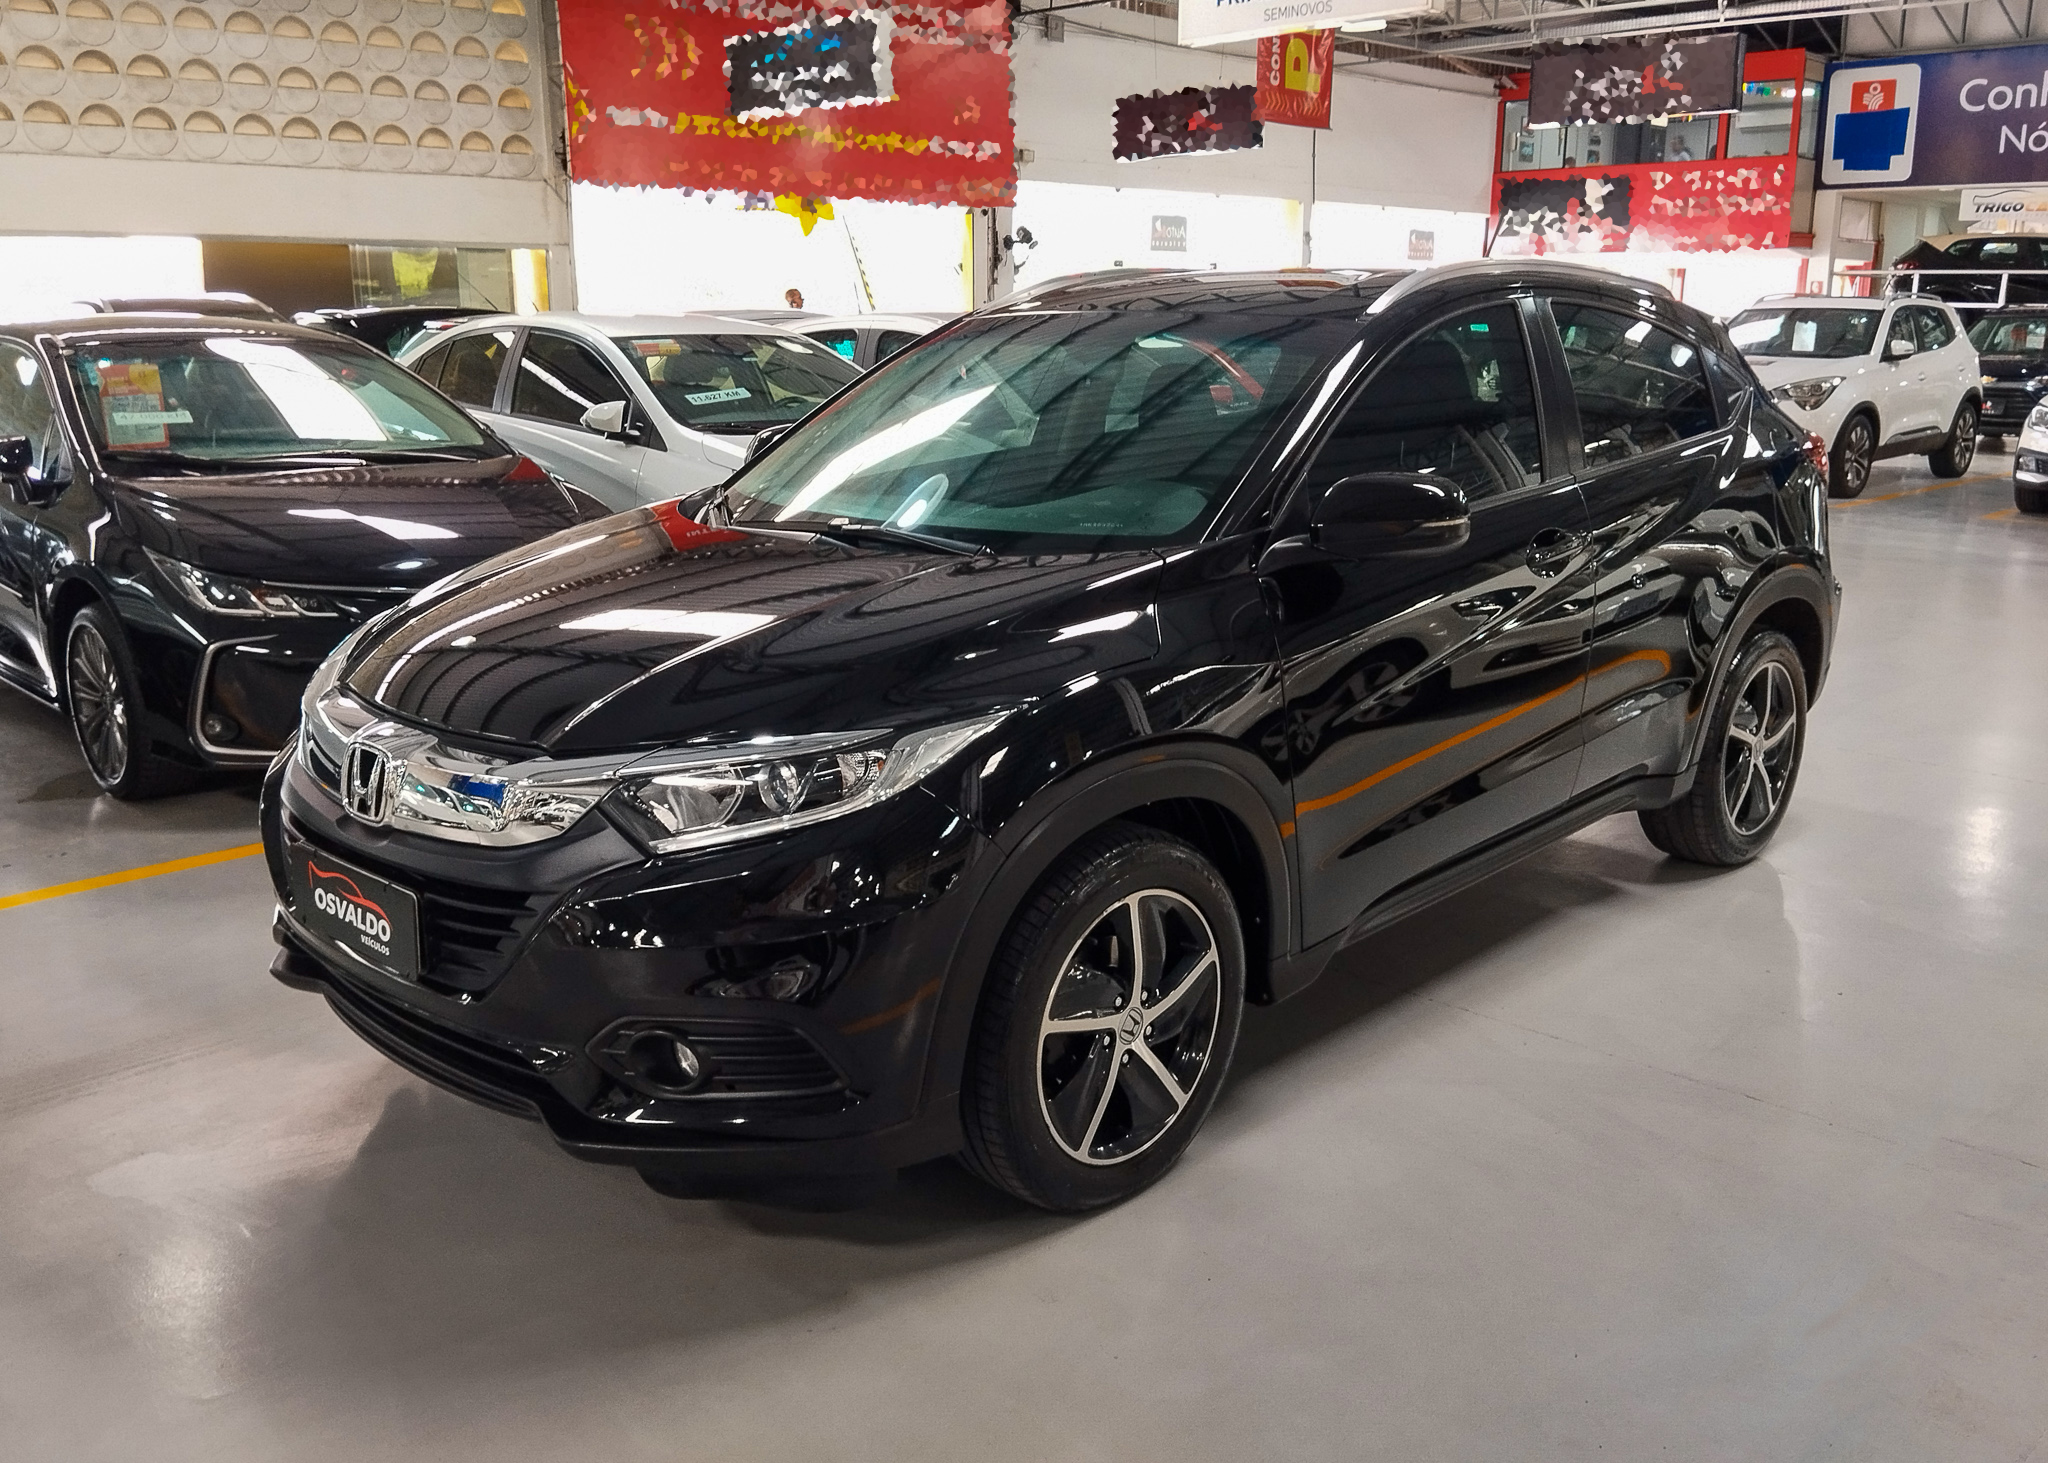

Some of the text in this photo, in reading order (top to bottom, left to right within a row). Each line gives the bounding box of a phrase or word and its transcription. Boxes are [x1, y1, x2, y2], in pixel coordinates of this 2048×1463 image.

[1263, 0, 1333, 21] SEMINOVOS
[723, 390, 741, 399] KM
[314, 887, 391, 942] OSVALDO
